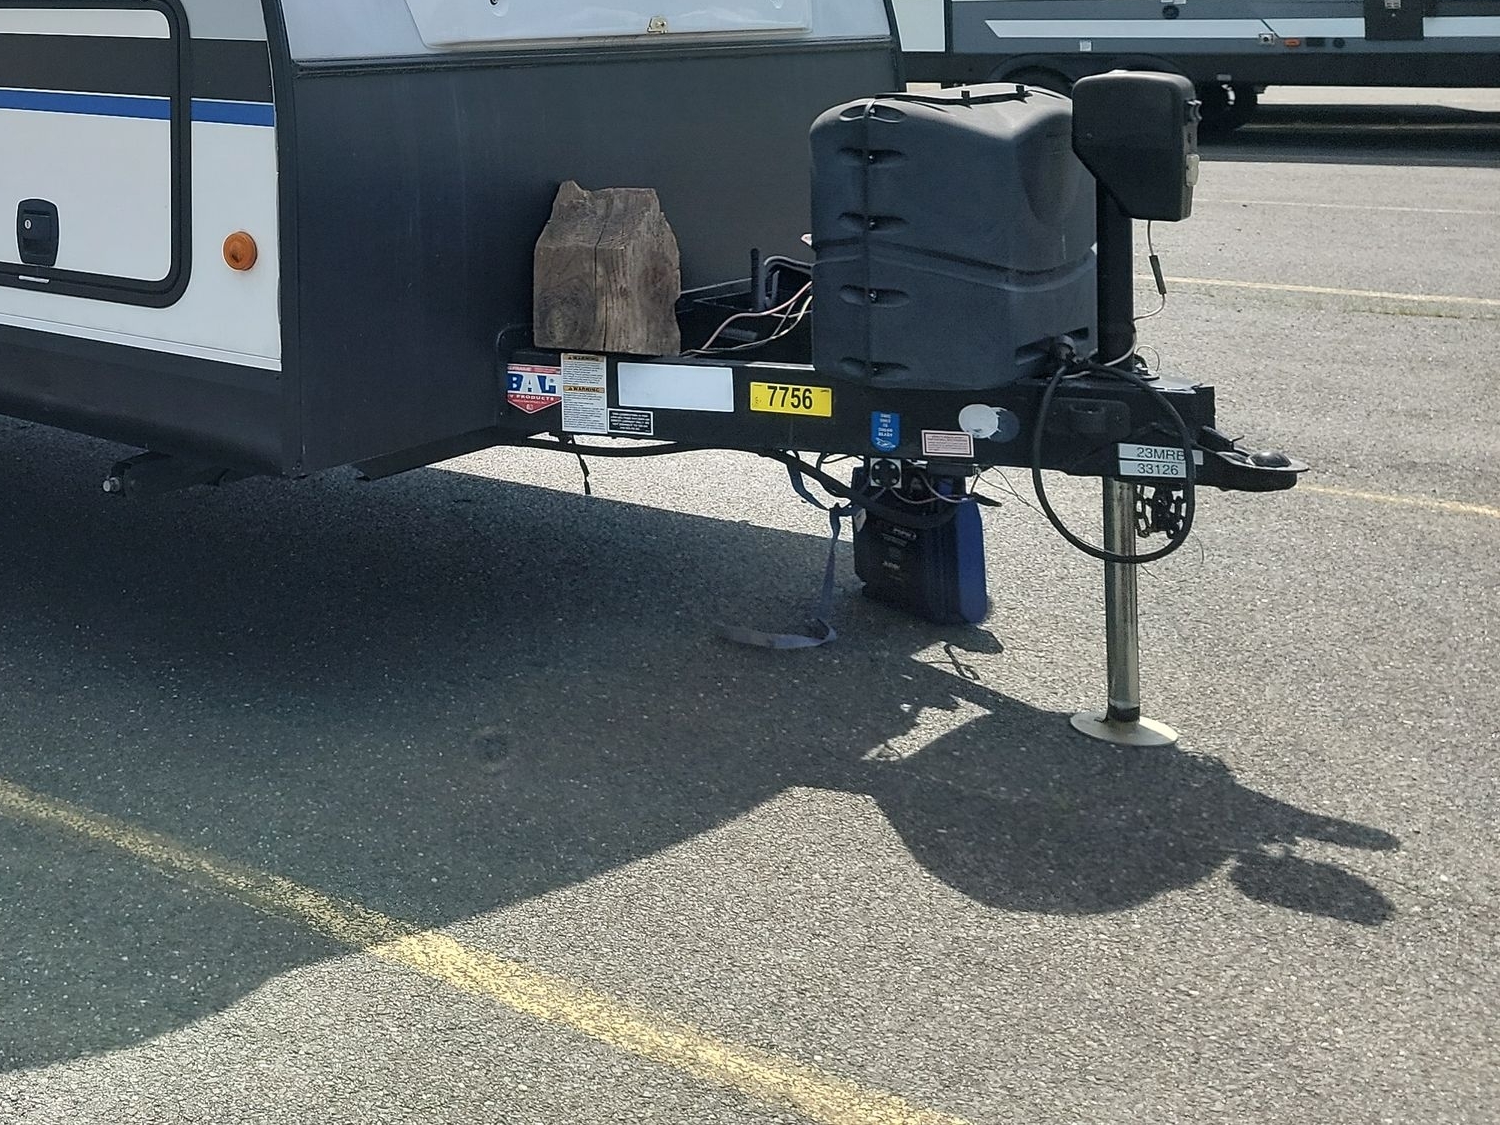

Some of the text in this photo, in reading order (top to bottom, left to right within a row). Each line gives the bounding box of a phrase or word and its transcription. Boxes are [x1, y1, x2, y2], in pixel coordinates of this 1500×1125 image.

[507, 373, 557, 393] BAL
[767, 385, 813, 410] 7756
[1137, 463, 1179, 476] 33126
